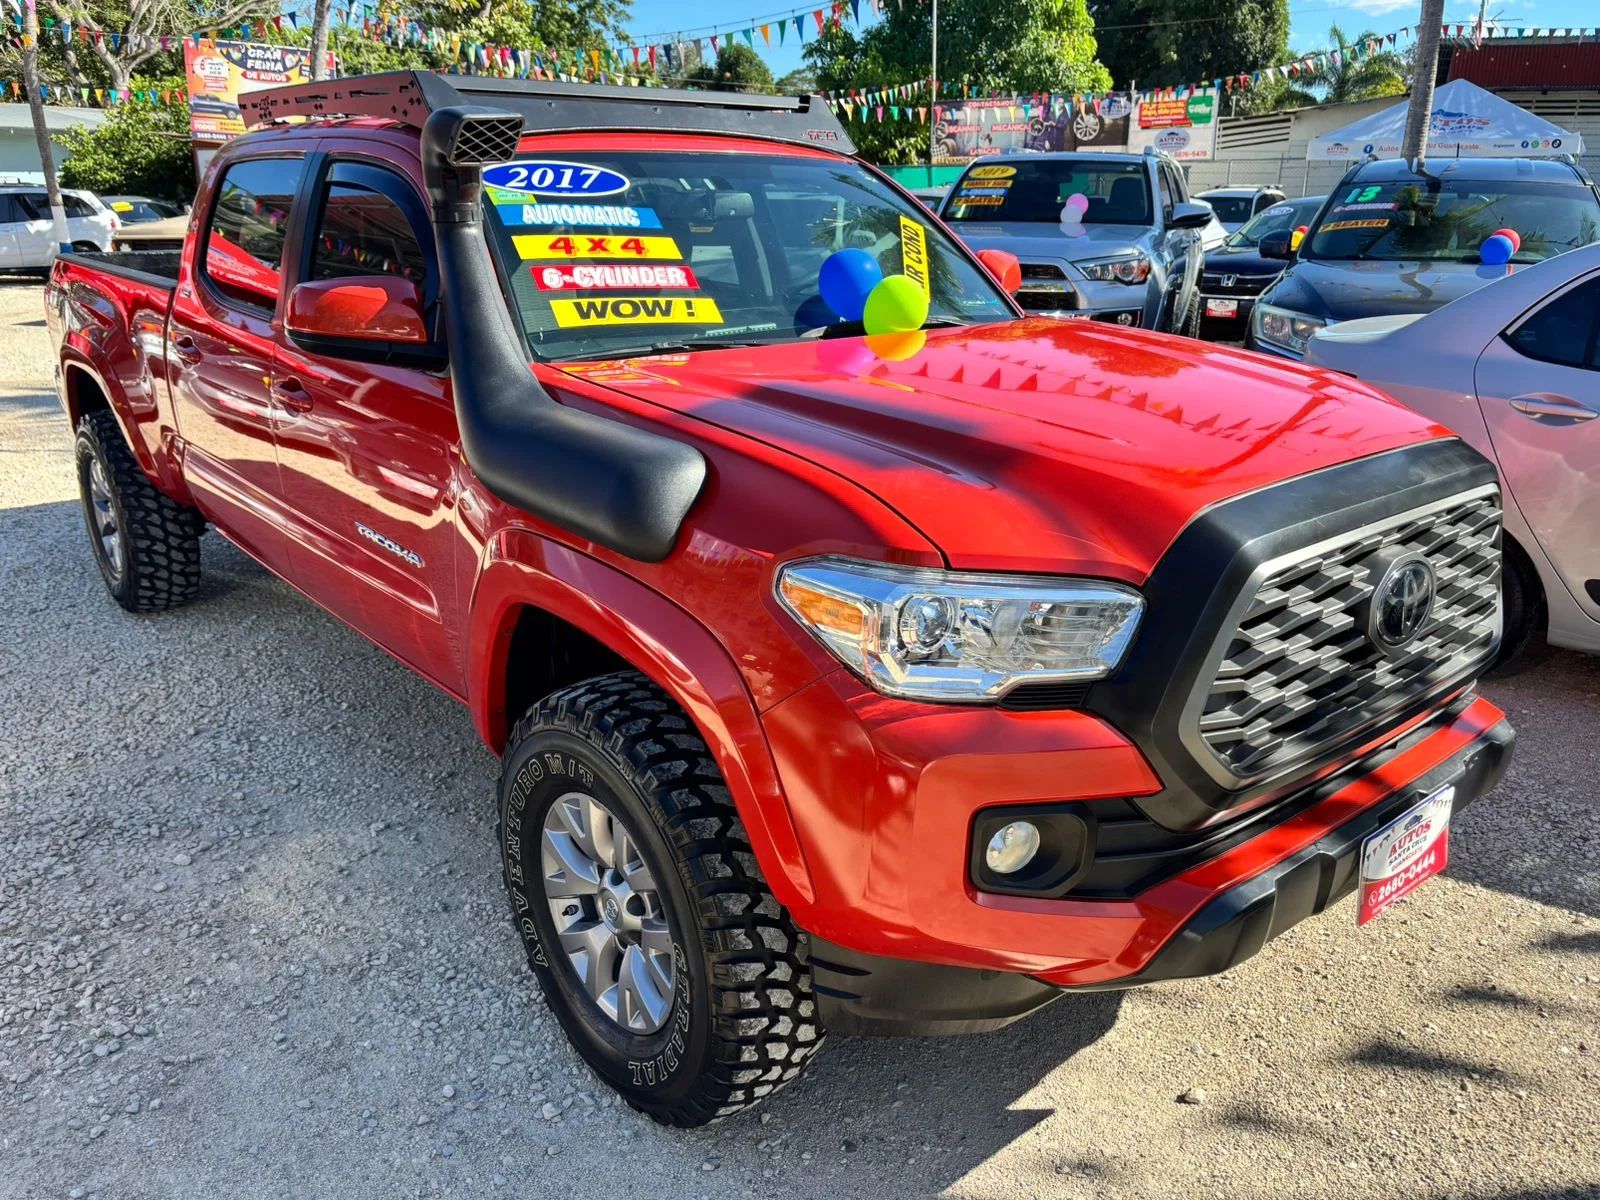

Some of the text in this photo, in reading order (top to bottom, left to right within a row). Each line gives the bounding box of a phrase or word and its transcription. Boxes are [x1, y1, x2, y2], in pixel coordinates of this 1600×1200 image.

[247, 48, 282, 60] GRAN
[246, 60, 284, 72] FERIA
[246, 70, 287, 82] DE AUTOS
[1379, 144, 1399, 152] Autos
[504, 167, 601, 188] 2017
[522, 205, 641, 227] AUTOMATIC
[1333, 218, 1387, 230] SEATER
[549, 237, 577, 255] 4
[620, 238, 648, 255] 4
[542, 266, 686, 288] 6-CYLINDER
[906, 264, 925, 289] IR
[573, 300, 672, 320] WOW
[1388, 820, 1432, 860] AUTOS
[507, 758, 549, 968] ADVENTURO
[1388, 846, 1411, 866] SANTA
[1377, 850, 1436, 901] 2680-0444
